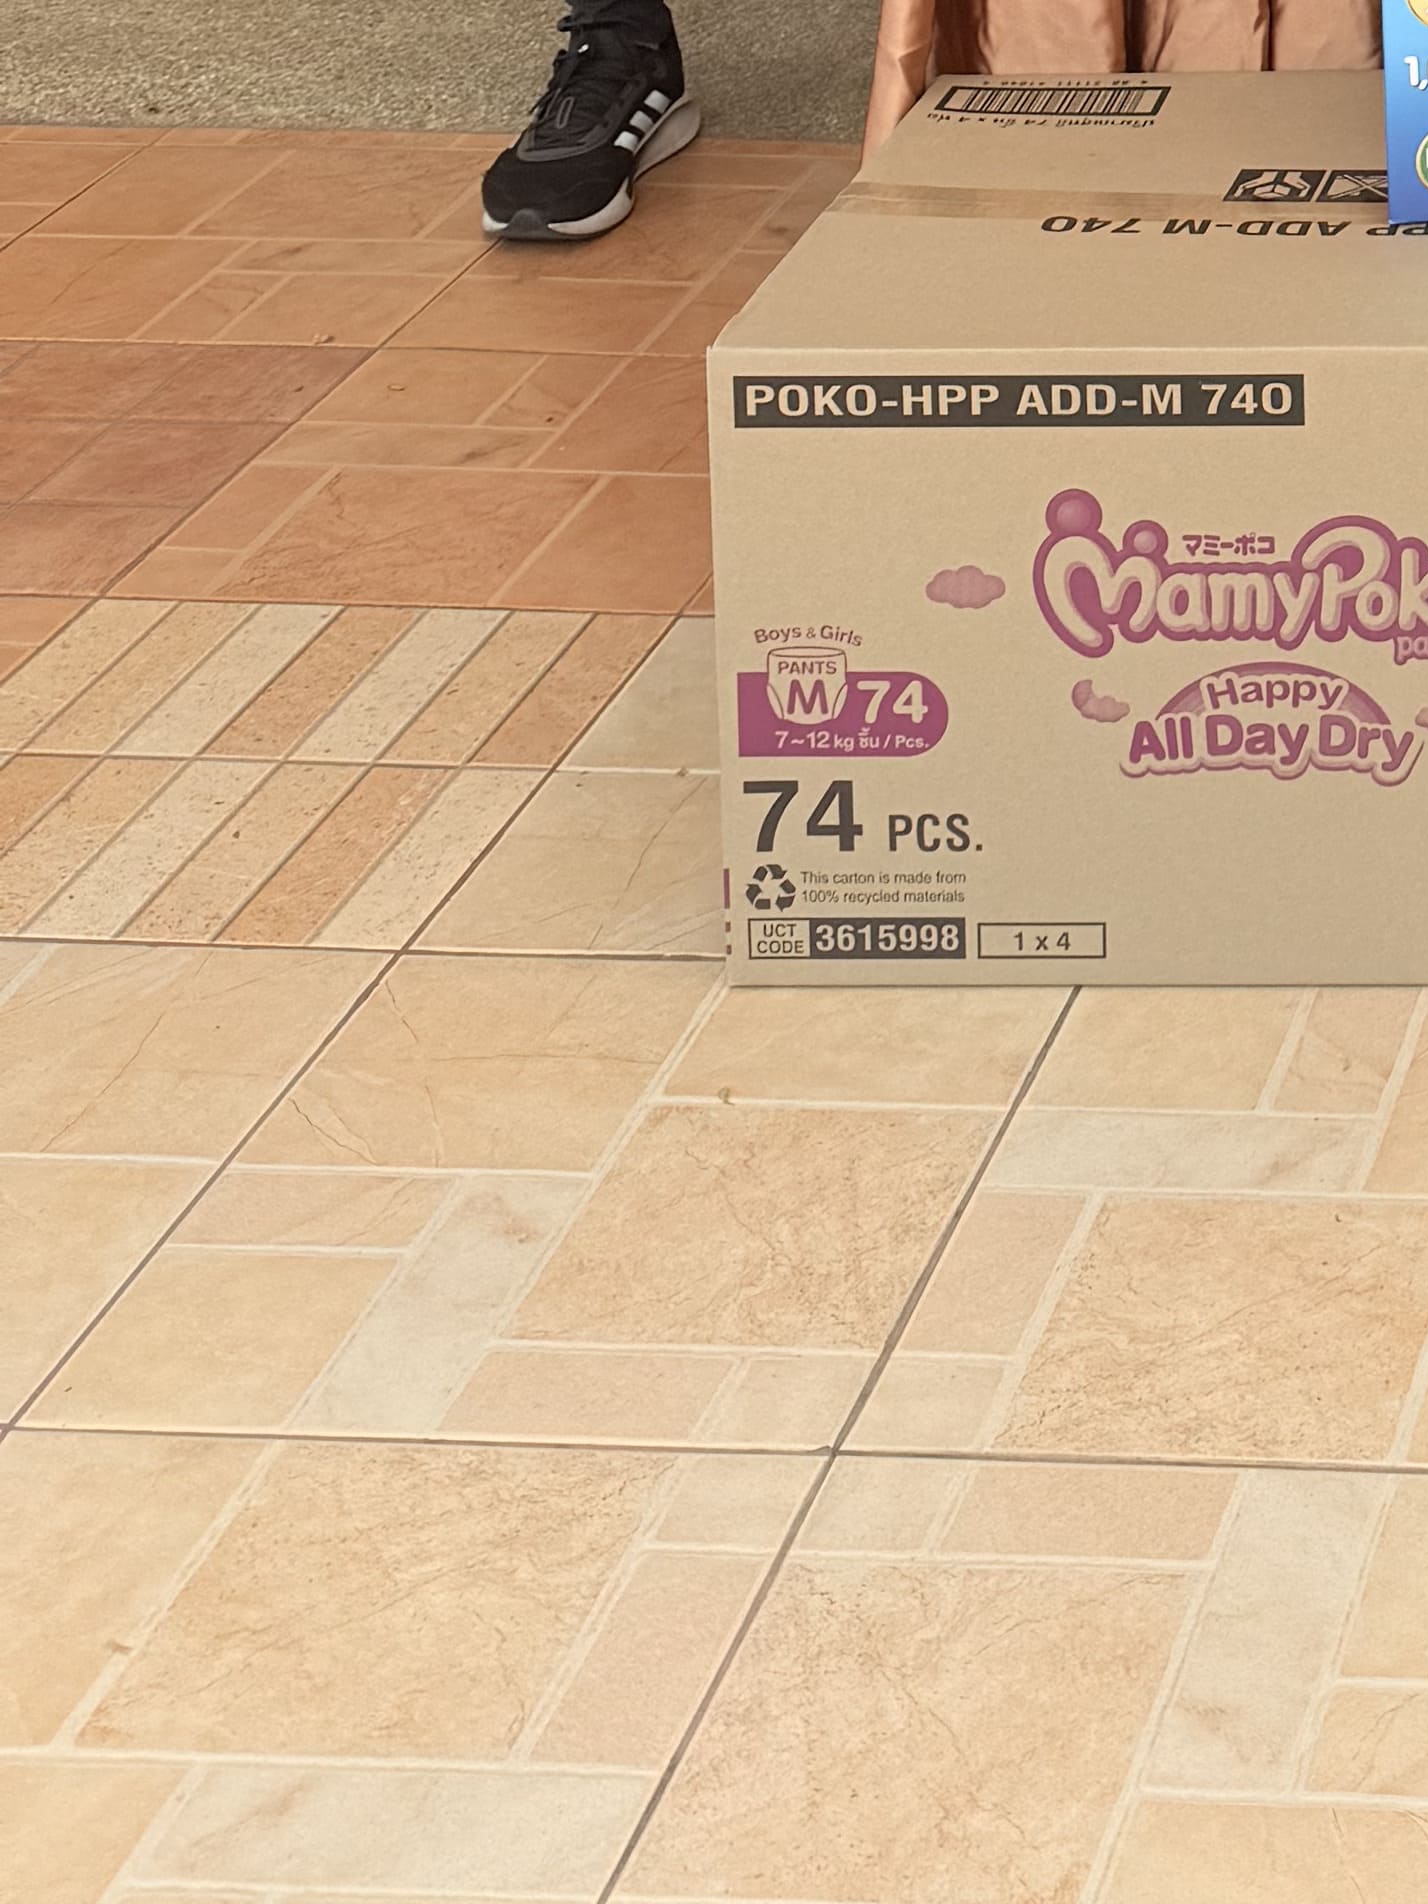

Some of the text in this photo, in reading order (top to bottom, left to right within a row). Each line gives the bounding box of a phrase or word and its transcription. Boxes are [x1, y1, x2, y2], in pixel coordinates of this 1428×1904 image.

[743, 381, 1295, 417] POKO-HPP ADD-M 740
[777, 660, 838, 676] PANTS
[787, 679, 929, 724] M 74
[1206, 674, 1344, 710] Happy
[1129, 719, 1419, 773] All Day Dry
[742, 779, 983, 853] 74 PCS.
[842, 888, 966, 905] recycled materials
[756, 939, 805, 955] CODE
[763, 923, 798, 939] UCT
[814, 922, 961, 954] 3615998
